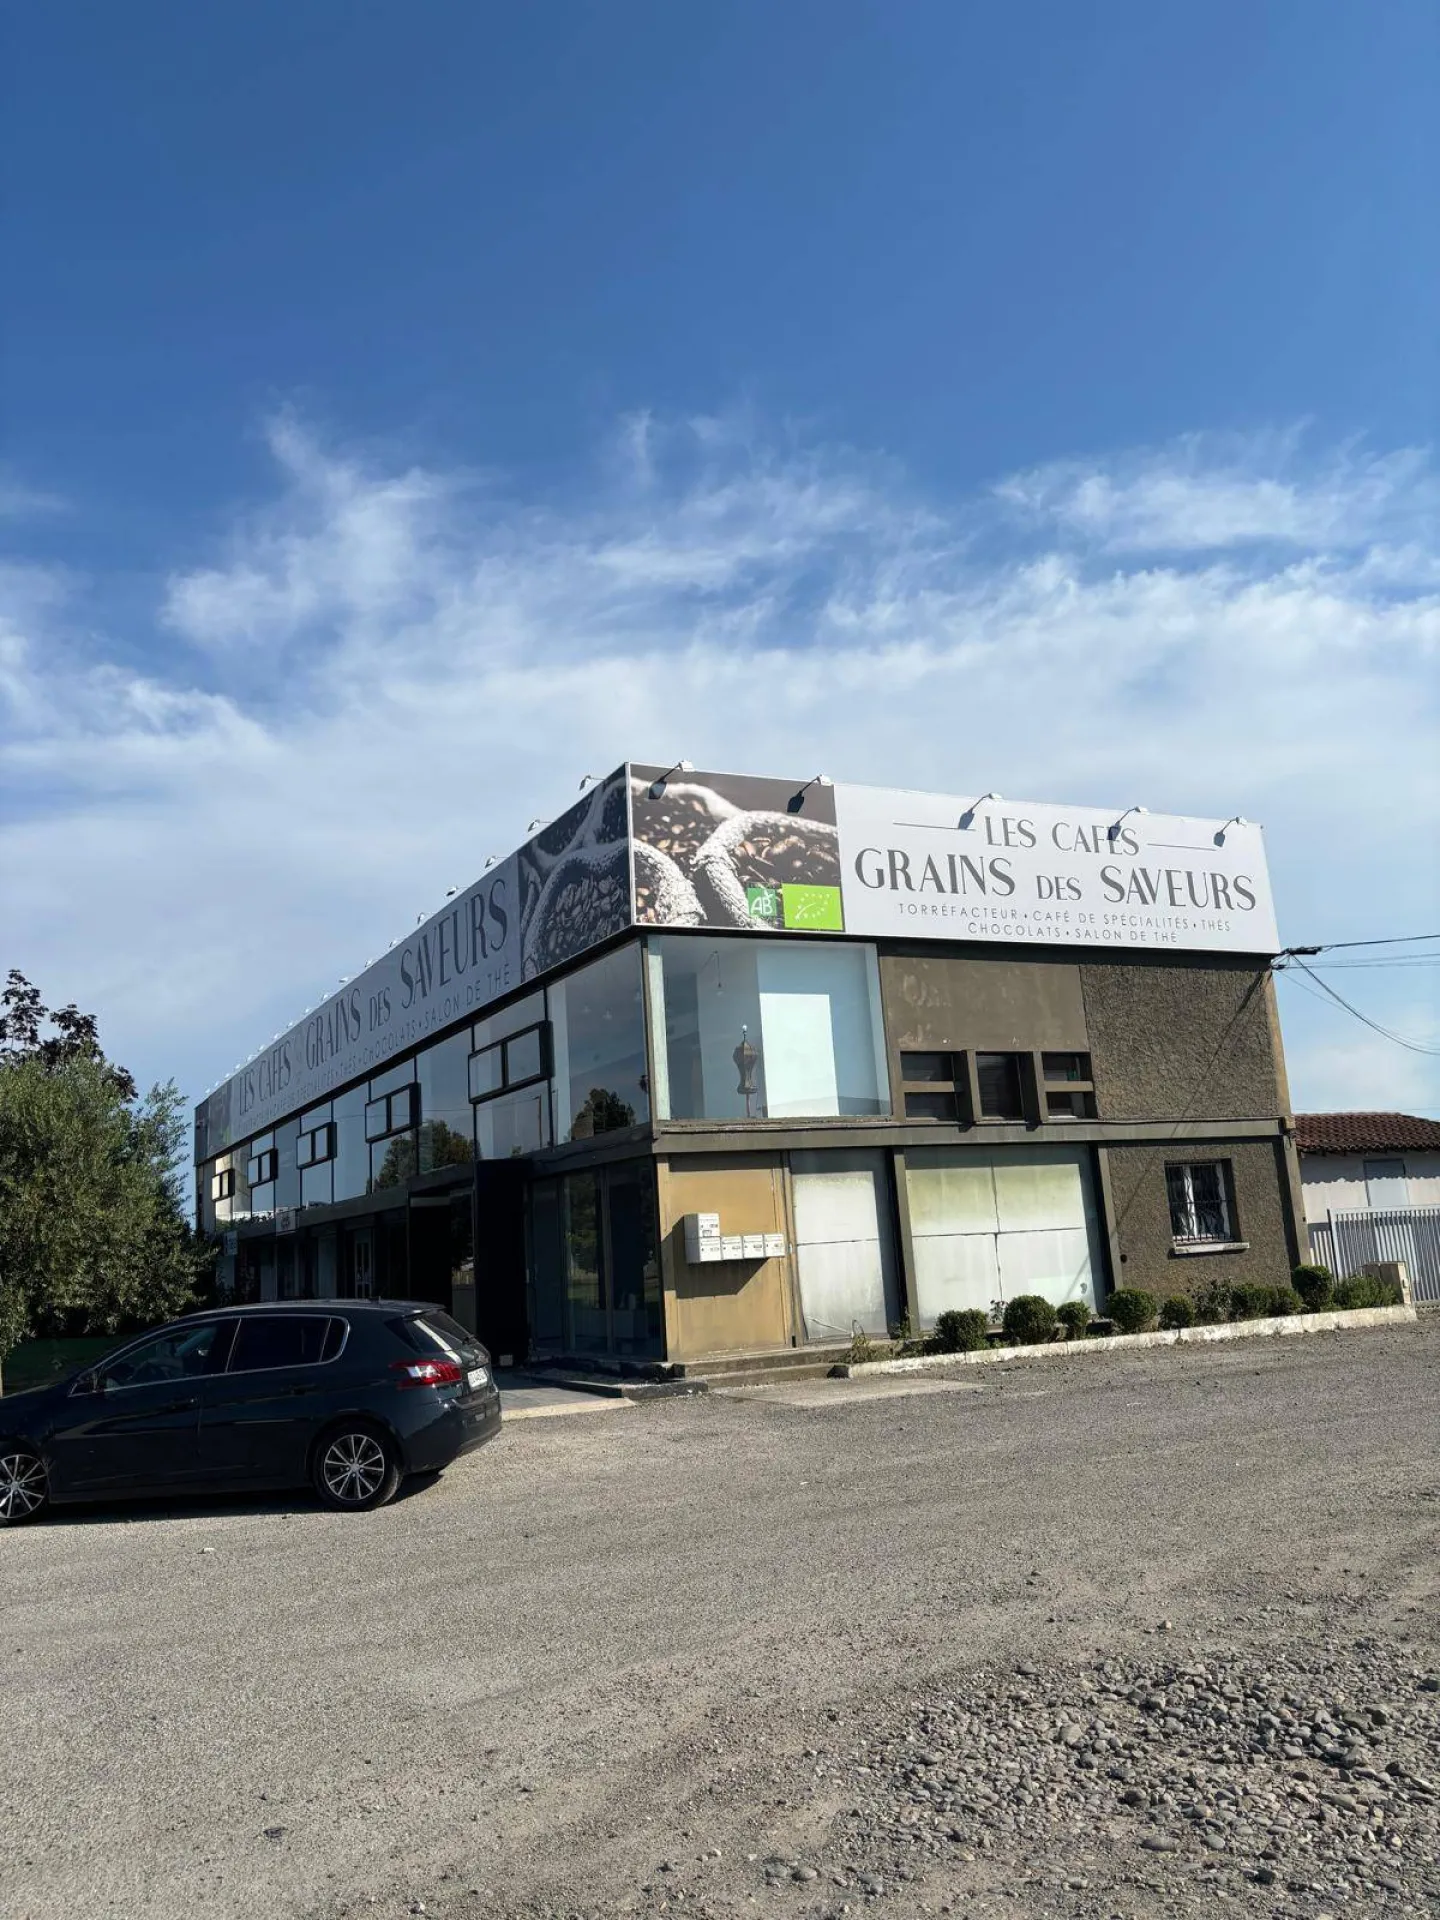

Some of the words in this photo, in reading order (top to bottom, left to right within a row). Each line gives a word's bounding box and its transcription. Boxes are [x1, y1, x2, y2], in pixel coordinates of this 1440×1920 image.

[984, 815, 1037, 848] LES
[854, 847, 1016, 896] GRAINS
[1036, 874, 1082, 901] DES
[1100, 865, 1256, 911] SAVEURS
[750, 895, 774, 915] AB
[898, 902, 1018, 920] TORRÉFACTEUR
[1032, 910, 1070, 923] CAFÉ
[1078, 912, 1096, 924] DE
[1103, 911, 1194, 931] SPÉCIALITÉS
[967, 922, 1061, 938] CHOCOLATS
[1075, 927, 1122, 940] SALON
[1129, 930, 1147, 941] DE
[1154, 930, 1177, 943] THÉ
[239, 1068, 255, 1116] LES
[305, 987, 361, 1070] GRAINS
[368, 986, 391, 1032] DES
[400, 878, 508, 1009] SAVEURS
[424, 993, 460, 1029] SALON
[466, 979, 481, 1008] DE
